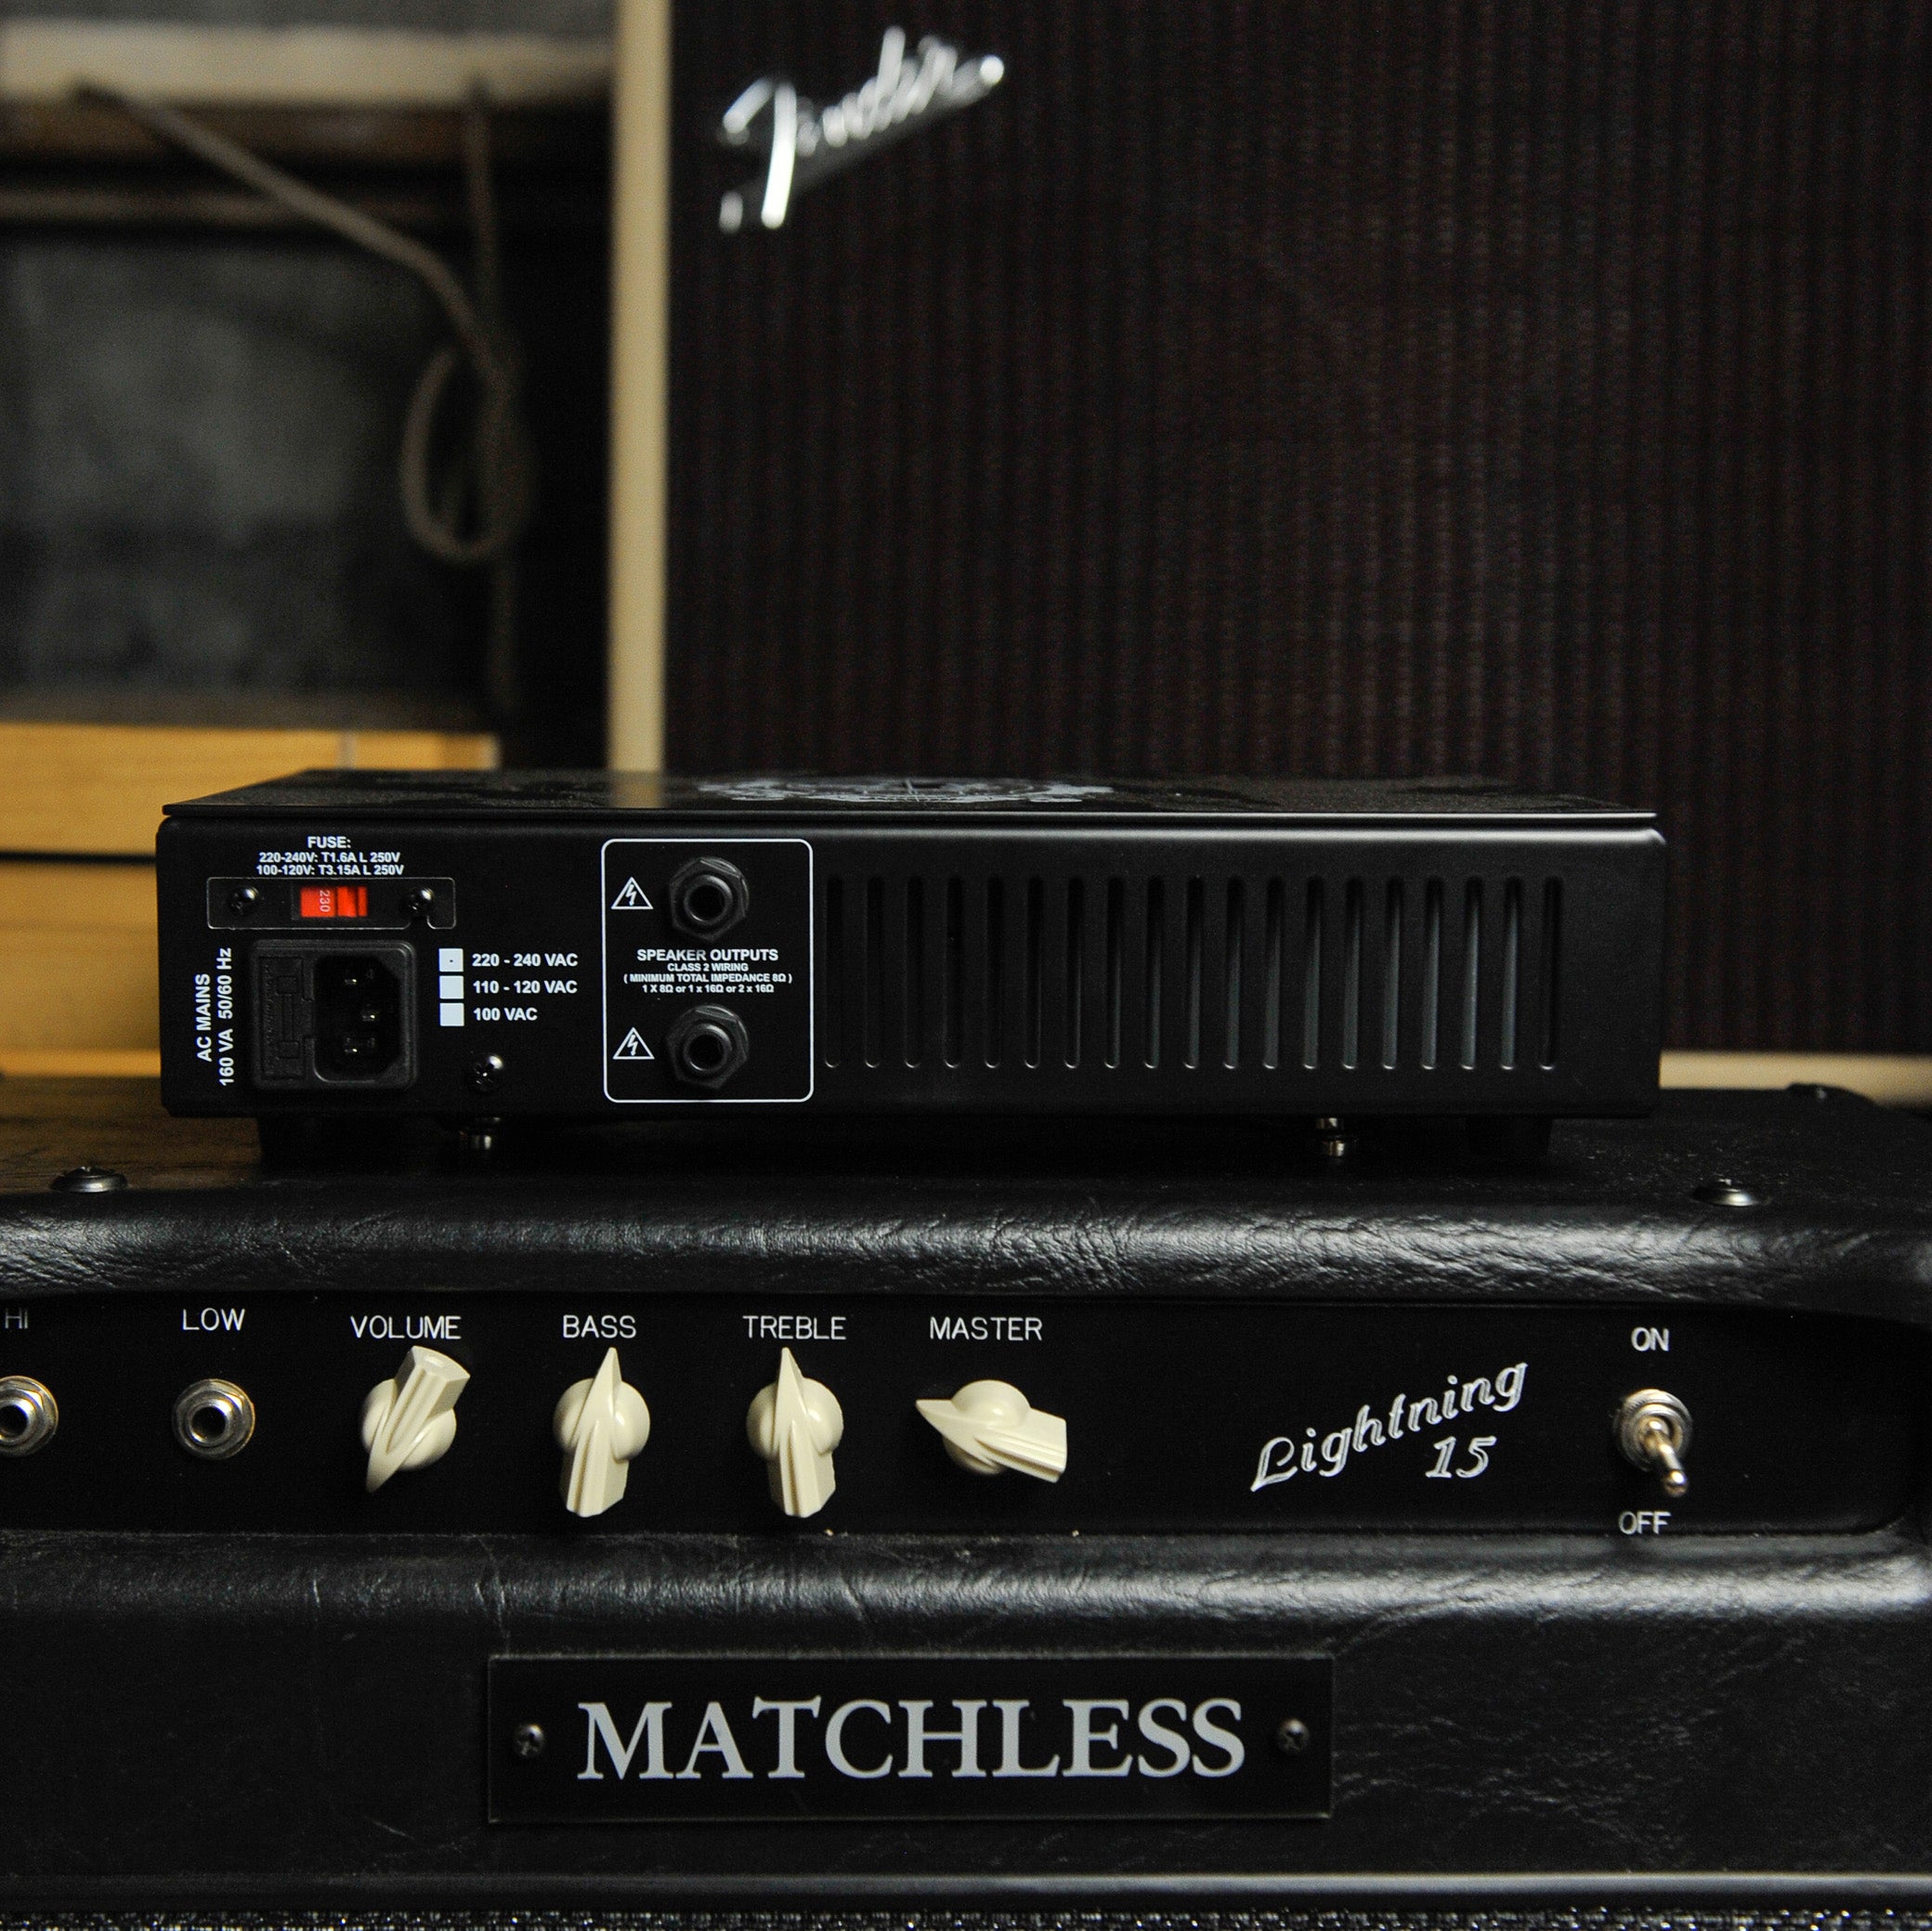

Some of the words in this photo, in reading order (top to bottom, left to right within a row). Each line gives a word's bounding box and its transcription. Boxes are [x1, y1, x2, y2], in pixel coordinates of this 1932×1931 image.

[307, 835, 351, 849] FUSE:
[258, 851, 319, 863] 220-240V:
[320, 851, 358, 863] T1.6A
[359, 853, 368, 863] L
[369, 851, 401, 863] 250V
[255, 864, 315, 876] 100-120V:
[317, 864, 361, 876] T3.15A
[362, 864, 372, 876] L
[373, 864, 405, 876] 250V
[319, 890, 331, 913] 230
[215, 947, 232, 970] Hz
[471, 953, 500, 967] 220
[513, 953, 542, 967] 240
[543, 952, 579, 967] VAC
[636, 948, 707, 961] SPEAKER
[710, 948, 779, 961] OUTPUTS
[629, 973, 675, 983] MINIMUM
[675, 973, 710, 983] TOTAL
[711, 973, 771, 983] IMPEDANCE
[667, 963, 702, 972] CLASS
[702, 963, 710, 972] 2
[711, 963, 750, 972] WIRING
[216, 974, 233, 1020] 50/60
[473, 980, 500, 994] 110
[513, 980, 541, 994] 120
[543, 980, 578, 994] VAC
[642, 985, 647, 993] 1
[687, 985, 694, 993] 1
[738, 985, 745, 993] 2
[194, 973, 212, 1030] MAINS
[473, 1007, 501, 1022] 100
[503, 1007, 538, 1021] VAC
[195, 1029, 213, 1063] AC
[217, 1028, 234, 1053] VA
[218, 1057, 235, 1087] 160
[5, 1307, 29, 1329] HI
[182, 1307, 246, 1331] LOW
[350, 1314, 462, 1340] VOLUME
[562, 1314, 637, 1339] BASS
[742, 1315, 846, 1340] TREBLE
[930, 1316, 1043, 1341] MASTER
[1631, 1326, 1670, 1352] ON
[1249, 1362, 1529, 1493] Lightning
[1425, 1435, 1497, 1479] 15
[1619, 1510, 1672, 1535] OFF
[577, 1695, 1246, 1781] MATCHLESS
